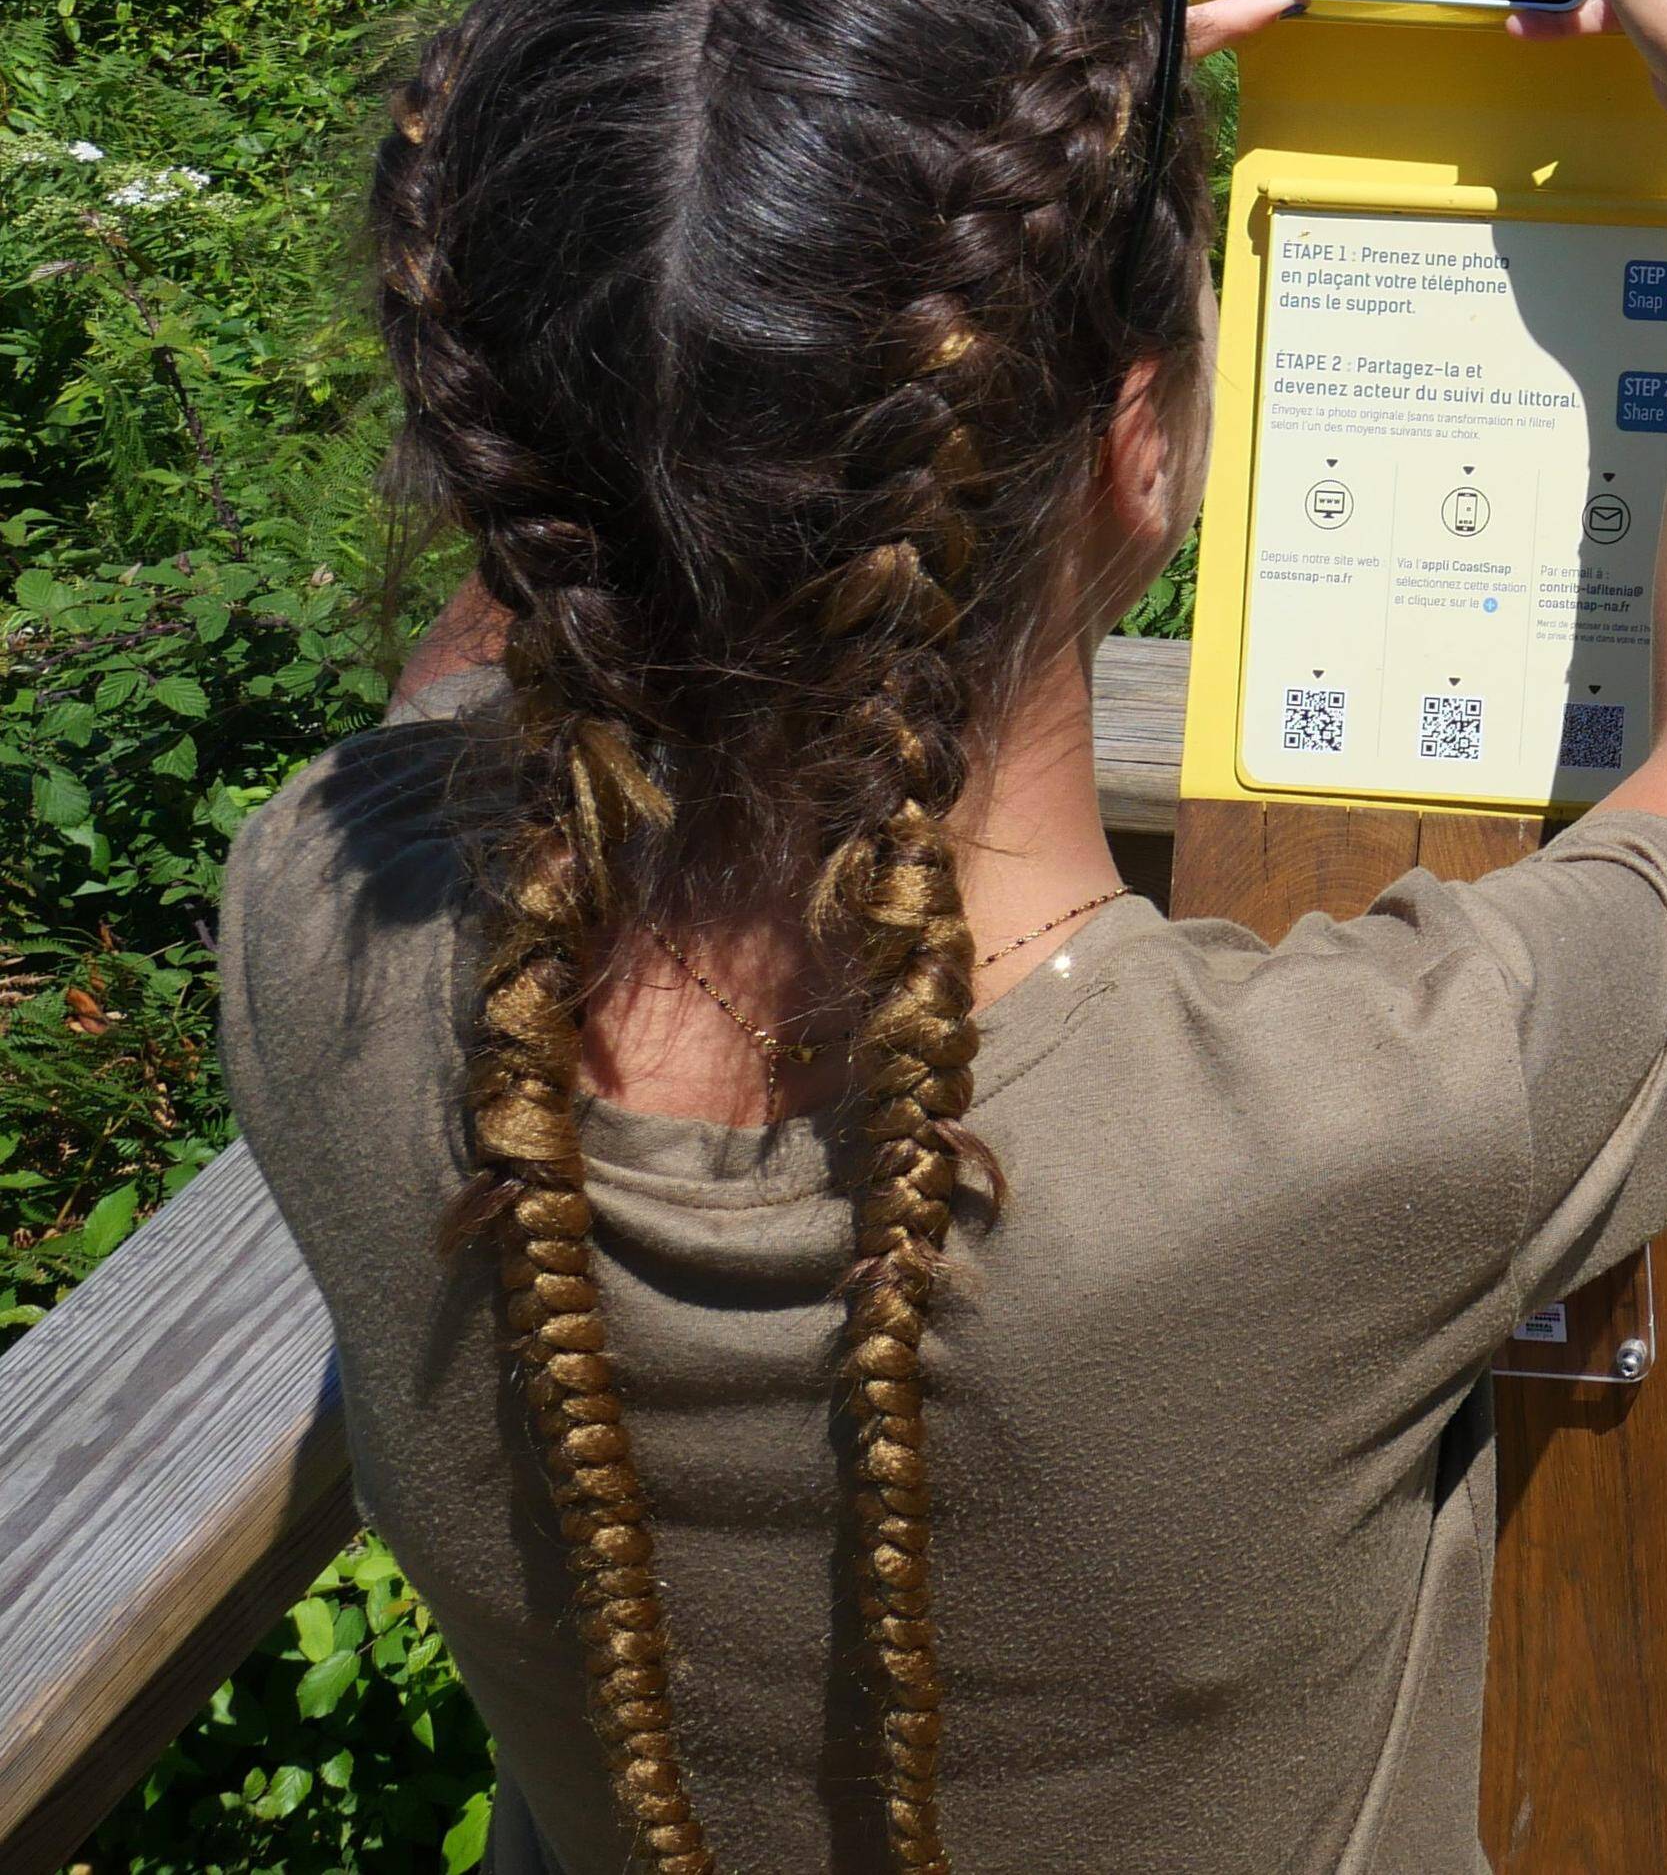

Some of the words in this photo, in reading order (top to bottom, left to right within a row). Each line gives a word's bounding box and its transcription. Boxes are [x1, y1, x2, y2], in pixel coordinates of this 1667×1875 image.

[1282, 239, 1334, 261] ÉTAPE
[1338, 245, 1347, 262] 1
[1361, 246, 1421, 266] Prenez
[1425, 253, 1457, 267] une
[1462, 252, 1510, 271] photo
[1281, 270, 1301, 283] en
[1307, 268, 1370, 290] plaçant
[1375, 274, 1417, 289] votre
[1421, 274, 1508, 295] téléphone
[1629, 265, 1666, 285] STEP
[1279, 291, 1321, 309] dans
[1326, 293, 1341, 310] le
[1345, 298, 1416, 316] support.
[1628, 290, 1663, 313] Snap
[1275, 349, 1327, 371] ÉTAPE
[1332, 355, 1342, 371] 2
[1356, 356, 1460, 380] Partagez-la
[1466, 363, 1483, 379] et
[1274, 377, 1348, 397] devenez
[1353, 383, 1411, 400] acteur
[1415, 384, 1437, 401] du
[1443, 386, 1484, 403] suivi
[1490, 388, 1511, 404] du
[1518, 389, 1581, 408] littoral.
[1624, 377, 1661, 397] STEP
[1271, 403, 1313, 417] Envoyez
[1316, 405, 1325, 416] la
[1327, 407, 1357, 419] photo
[1360, 408, 1404, 422] originale
[1437, 413, 1514, 427] transformation
[1516, 417, 1526, 427] ni
[1623, 402, 1664, 422] Share
[1270, 419, 1299, 430] selon
[1324, 421, 1343, 432] des
[1346, 424, 1387, 437] moyens
[1390, 425, 1433, 437] suivants
[1435, 429, 1448, 438] au
[1260, 550, 1299, 563] Depuis
[1302, 554, 1330, 564] notre
[1334, 555, 1354, 566] site
[1357, 556, 1380, 567] web
[1397, 557, 1413, 569] Via
[1452, 561, 1512, 576] CoastSnap
[1260, 570, 1353, 584] coastsnap-na.fr
[1541, 565, 1558, 577] Par
[1464, 581, 1490, 591] cette
[1492, 582, 1527, 593] station
[1394, 595, 1404, 605] et
[1407, 595, 1446, 608] cliquez
[1450, 598, 1467, 607] sur
[1538, 598, 1631, 613] coastsnap-na.fr
